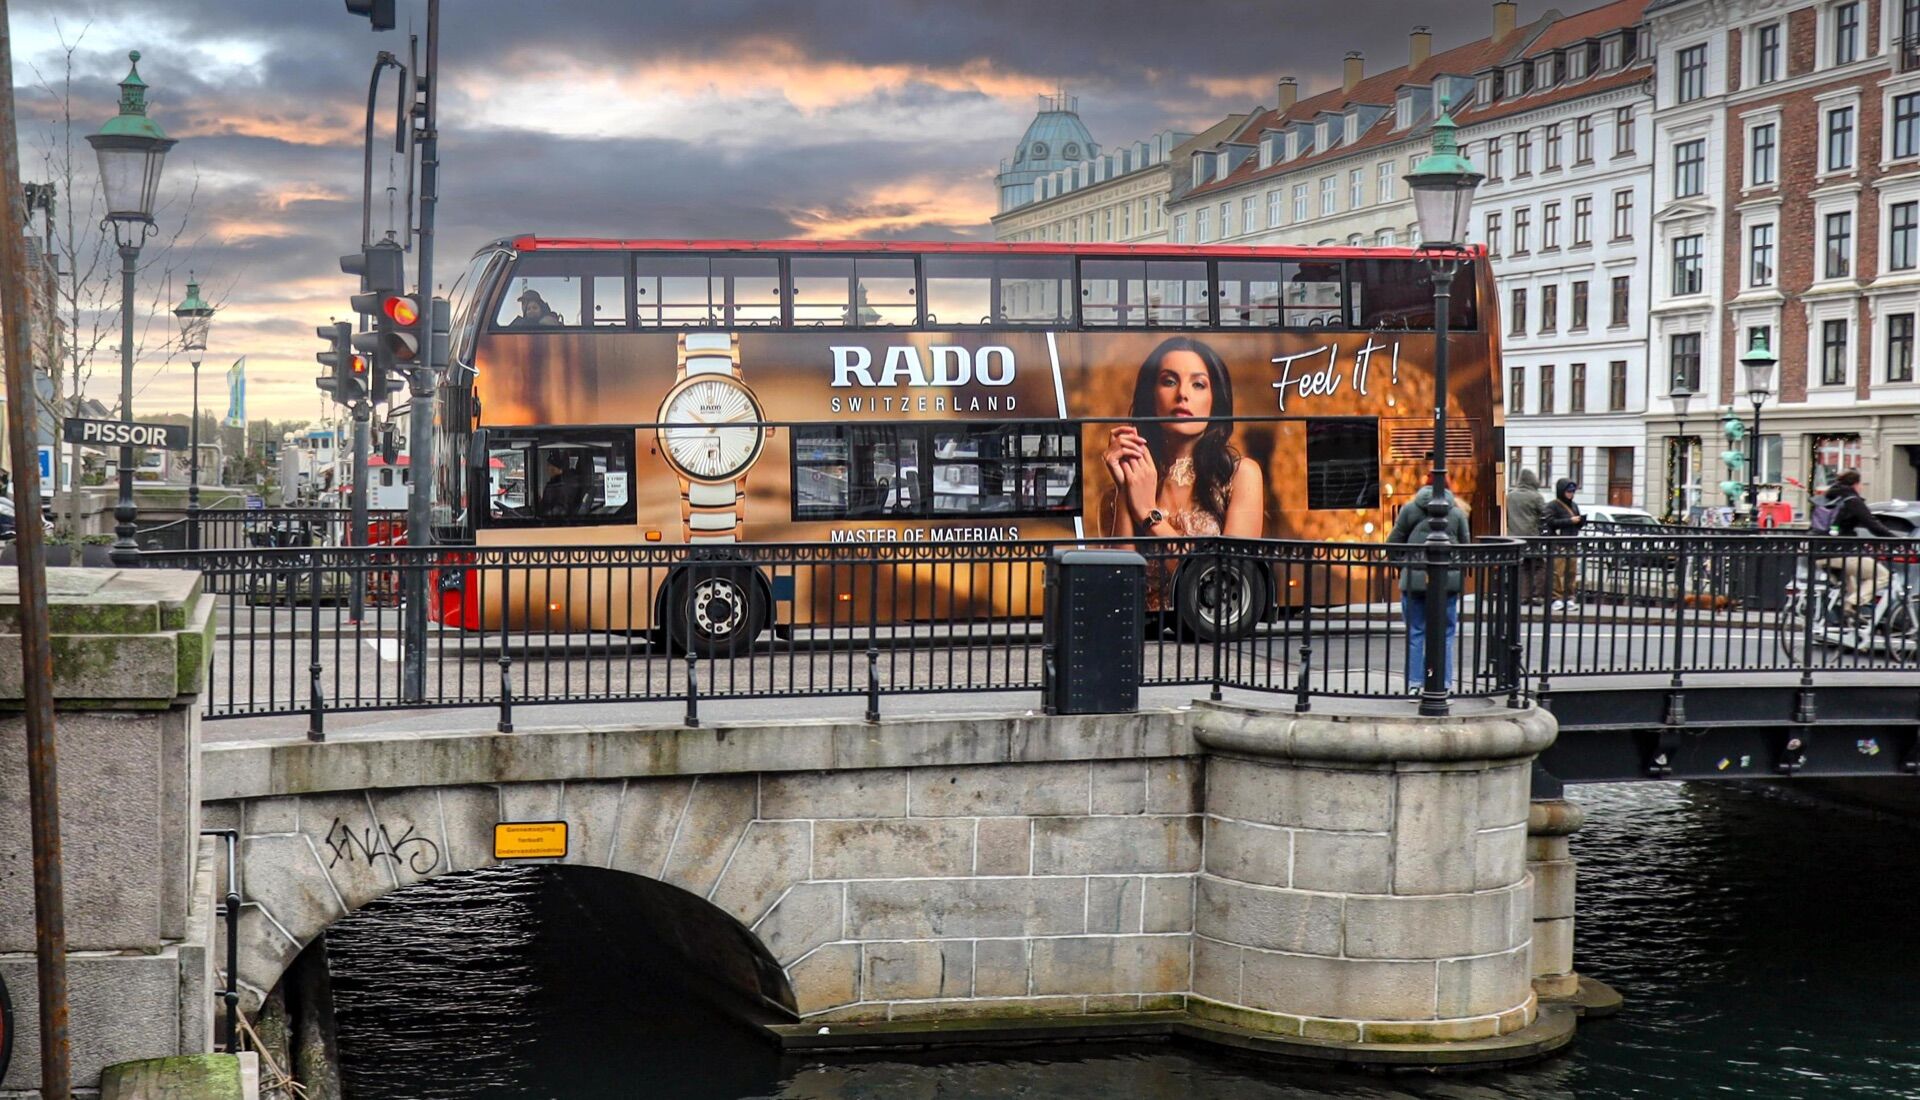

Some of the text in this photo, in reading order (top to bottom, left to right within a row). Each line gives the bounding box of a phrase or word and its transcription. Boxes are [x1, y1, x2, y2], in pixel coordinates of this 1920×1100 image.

[830, 346, 1016, 387] RADO
[1271, 343, 1342, 412] Feel
[831, 396, 1017, 412] SWITZERLAND
[83, 422, 168, 446] PISSOIR
[831, 530, 897, 542] MASTER
